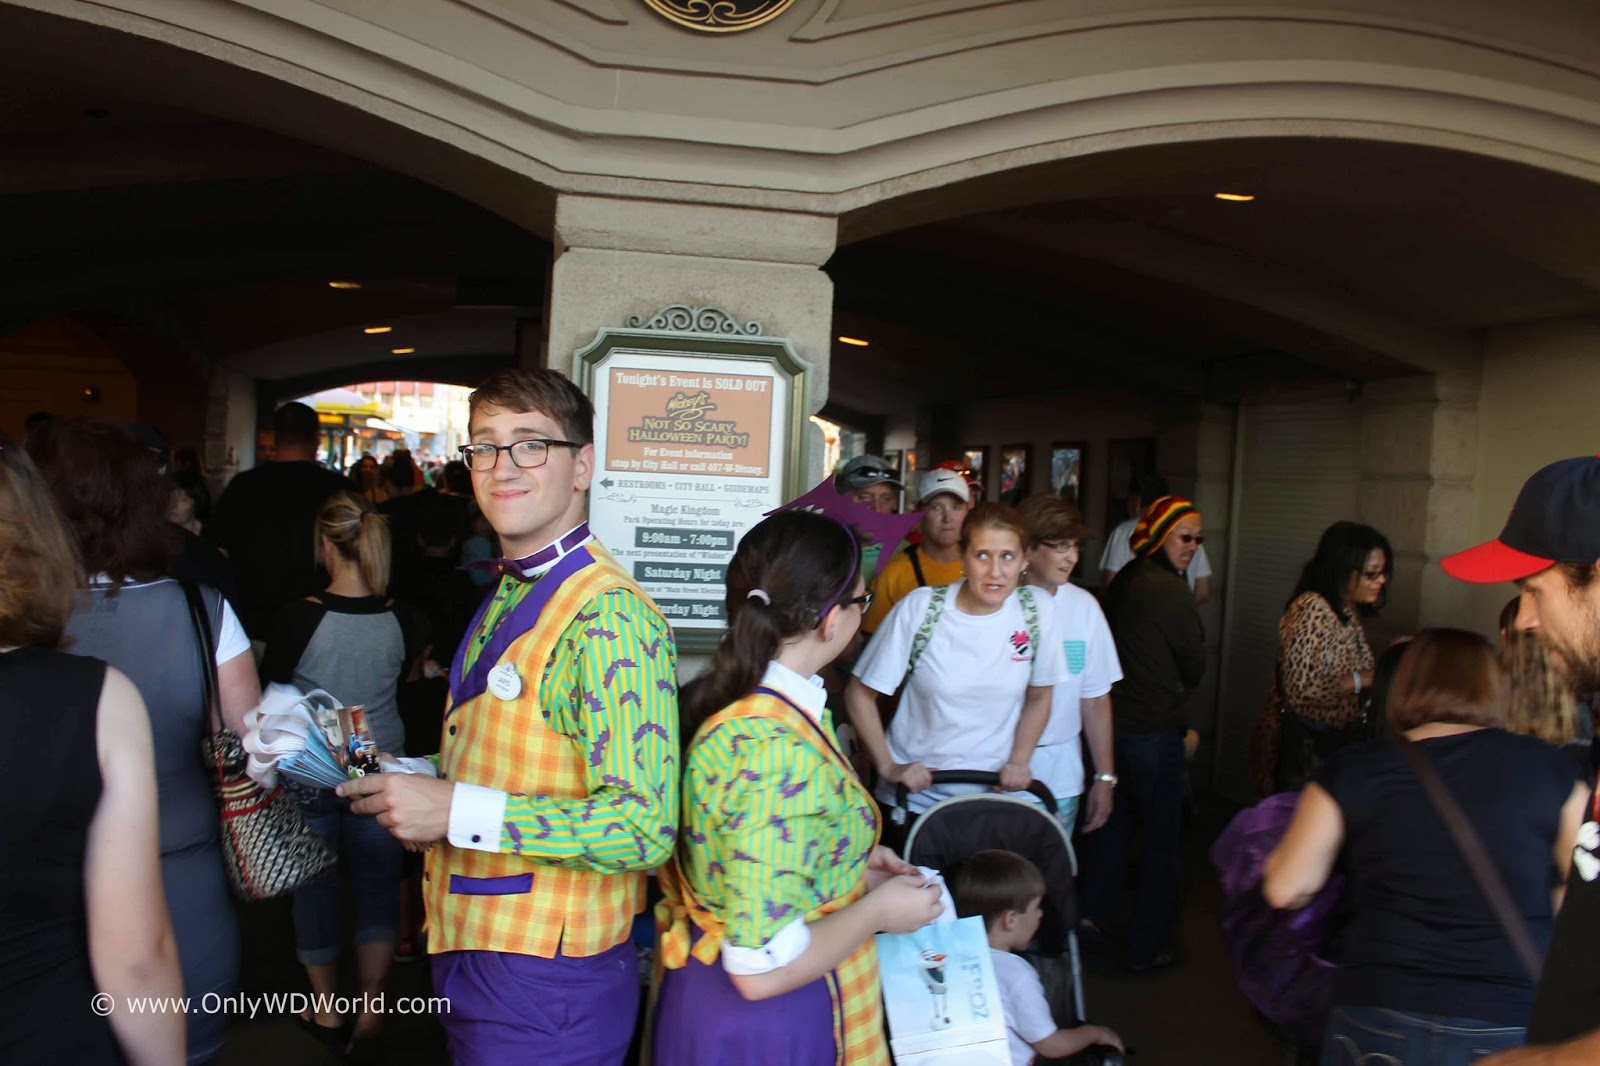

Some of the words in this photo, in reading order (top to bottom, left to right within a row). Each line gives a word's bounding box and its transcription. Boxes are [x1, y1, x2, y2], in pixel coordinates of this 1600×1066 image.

[616, 372, 666, 387] Tonight's
[669, 375, 700, 388] Event
[703, 377, 712, 389] is
[715, 378, 743, 391] SOLD
[745, 379, 768, 392] OUT
[644, 417, 671, 430] NOT
[674, 419, 692, 432] SO
[695, 420, 735, 435] SCARY
[630, 429, 701, 443] HALLOWEEN
[643, 447, 657, 456] For
[660, 448, 683, 457] Event
[611, 459, 630, 469] stop
[631, 459, 641, 470] by
[643, 459, 660, 471] City
[661, 461, 678, 470] Hall
[679, 462, 689, 470] or
[690, 462, 706, 472] call
[618, 479, 666, 490] RESTROOMS
[675, 481, 693, 491] CITY
[695, 482, 715, 492] HALL
[724, 484, 769, 494] GUIDEMAPS
[651, 503, 678, 514] Magic
[681, 505, 720, 517] Kingdom
[624, 515, 640, 523] Park
[642, 516, 676, 526] Operating
[678, 518, 698, 526] Hours
[700, 518, 710, 527] for
[711, 519, 730, 528] today
[642, 532, 681, 545] 9:00am
[690, 534, 728, 547] 7:00pm
[612, 548, 624, 556] The
[627, 549, 641, 557] next
[643, 549, 687, 559] presentation
[689, 550, 696, 558] of
[644, 566, 692, 580] Saturday
[693, 567, 721, 582] Night
[656, 603, 691, 617] turday
[691, 604, 719, 618] Night
